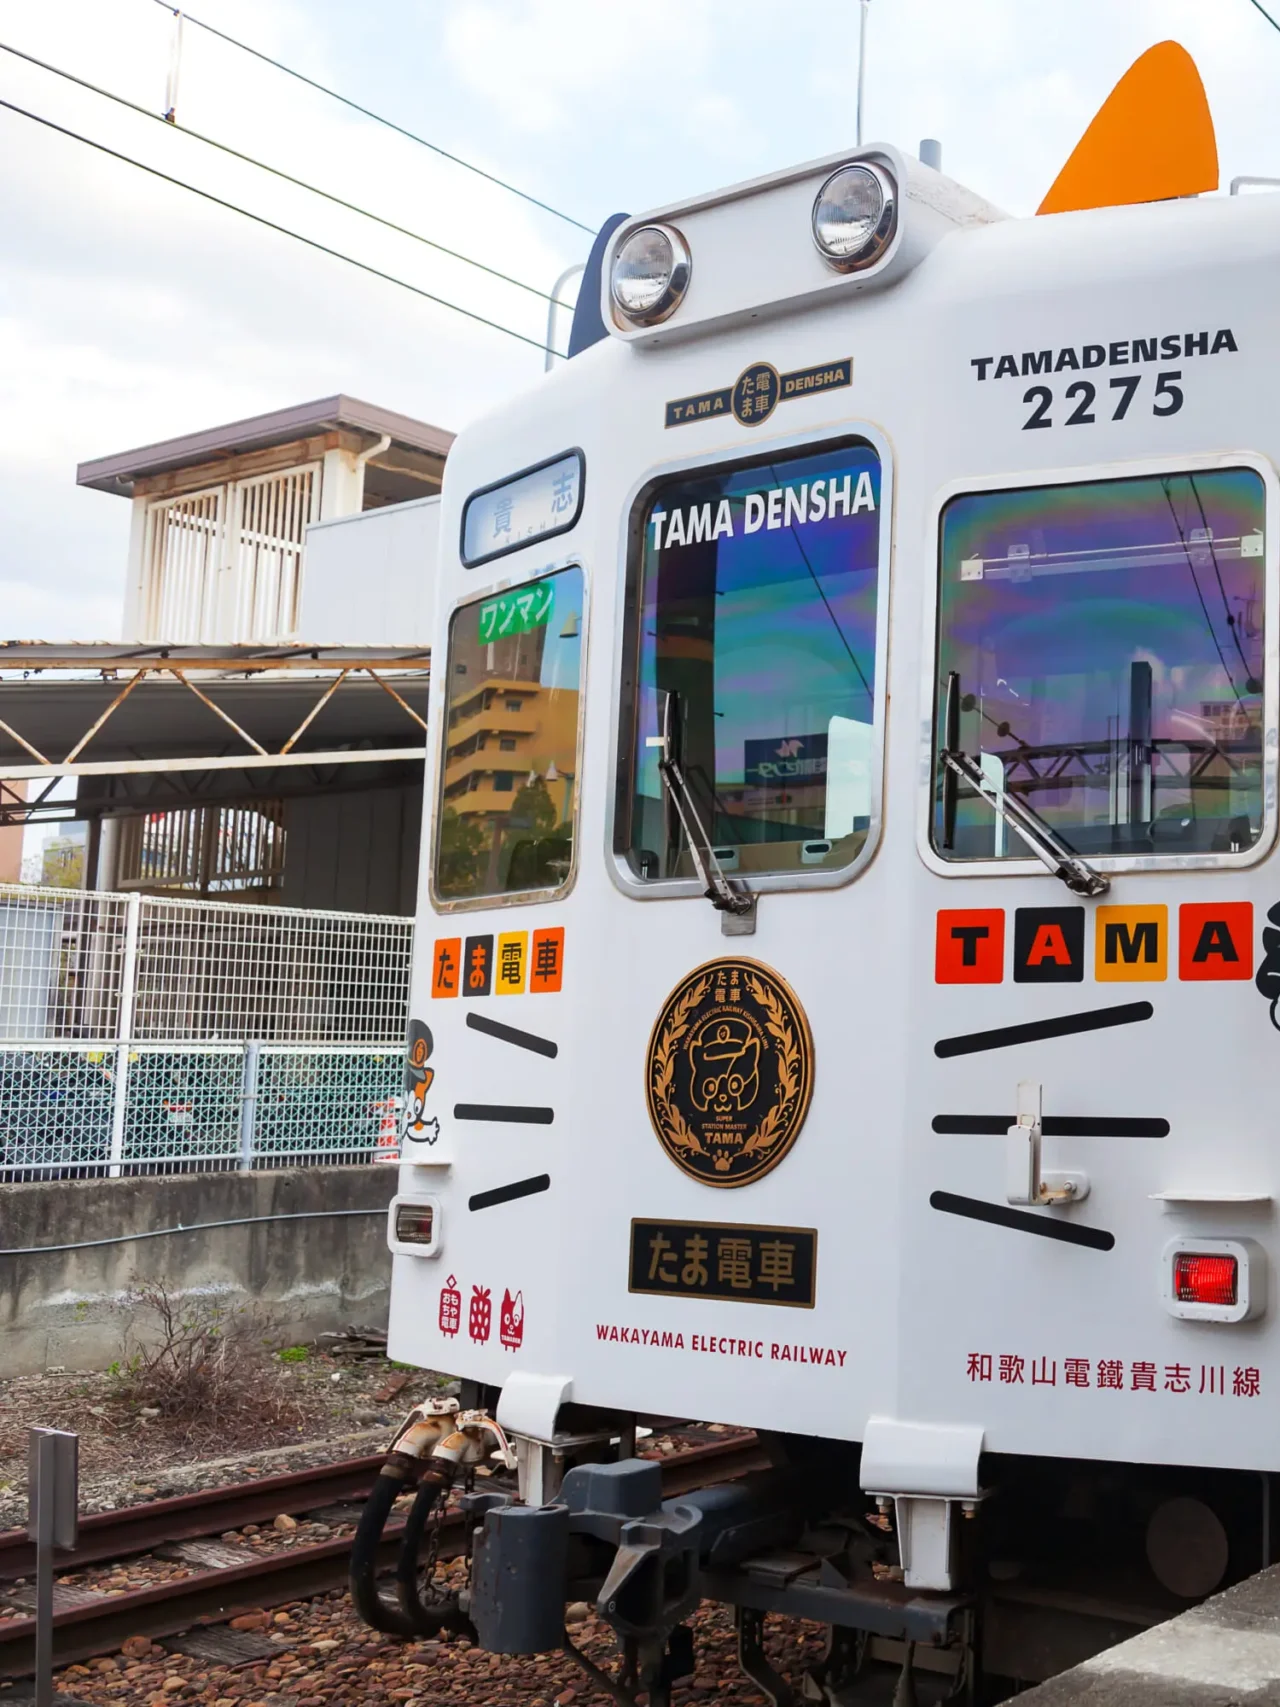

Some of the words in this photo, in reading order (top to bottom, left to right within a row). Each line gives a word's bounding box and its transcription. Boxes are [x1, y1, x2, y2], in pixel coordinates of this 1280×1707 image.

[971, 328, 1238, 381] TAMADENSHA
[674, 397, 723, 419] TAMA
[785, 368, 844, 393] DENSHA
[1021, 370, 1184, 430] 2275
[493, 472, 576, 538] 貴志
[651, 499, 734, 550] TAMA
[744, 471, 876, 534] DENSHA
[481, 587, 553, 638] ワンマン
[437, 938, 559, 989] たま電車
[951, 921, 1240, 966] TAMA
[717, 970, 739, 986] たま
[701, 1005, 721, 1021] ELECTRIC
[721, 1005, 744, 1014] RAILWAY
[704, 1132, 744, 1144] TAMA
[648, 1231, 796, 1292] たま電車
[596, 1324, 684, 1349] WAKAYAMA
[691, 1334, 763, 1358] ELECTRIC
[771, 1343, 848, 1367] RAILWAY
[966, 1352, 1261, 1398] 和歌山電鐵貴志川線
